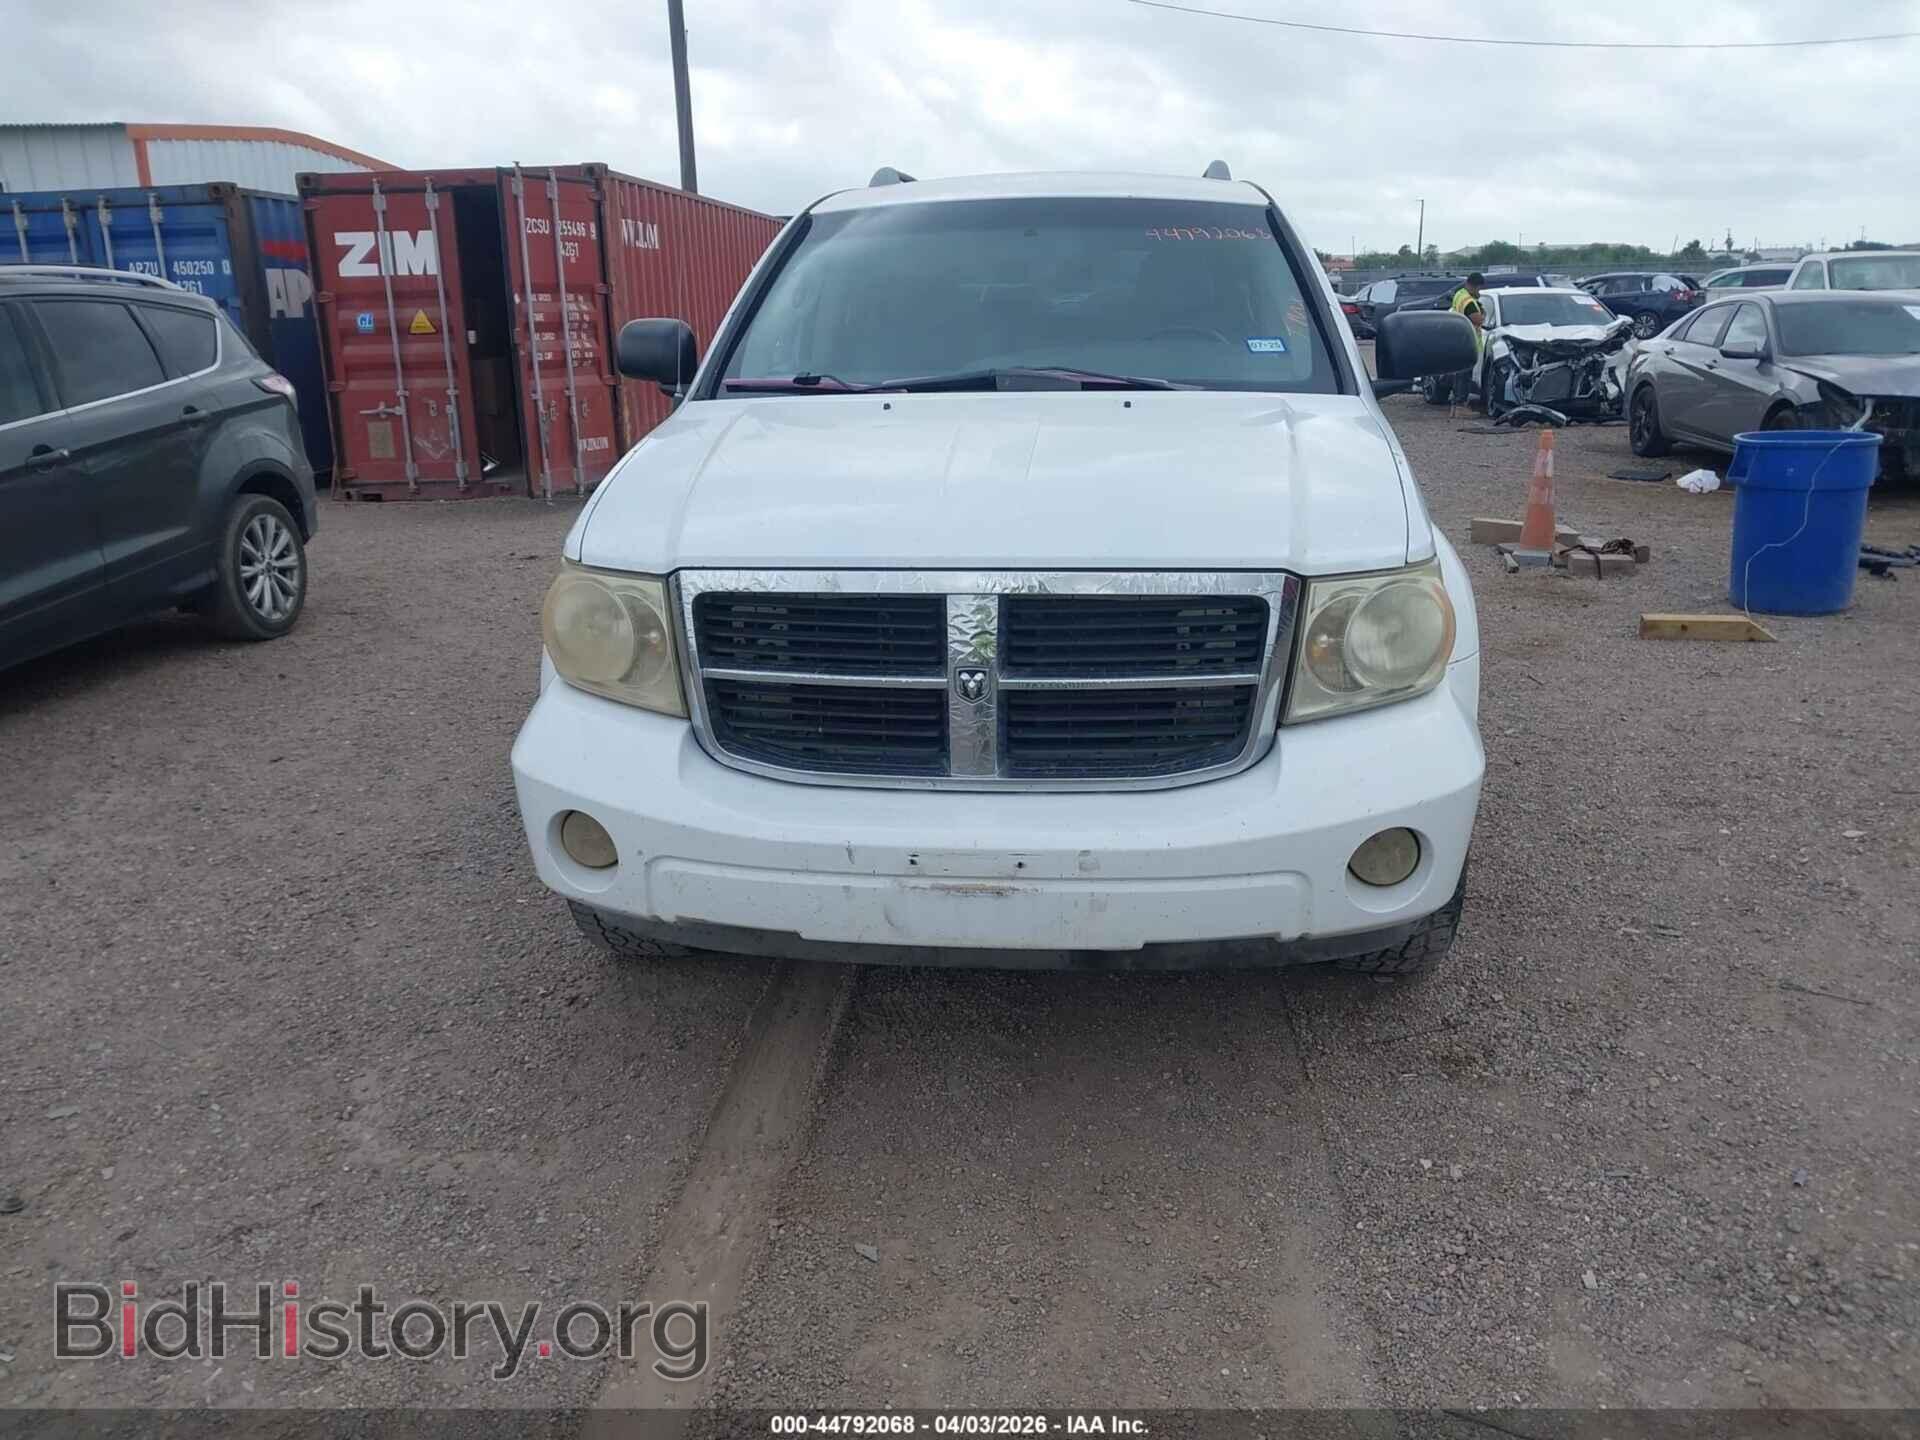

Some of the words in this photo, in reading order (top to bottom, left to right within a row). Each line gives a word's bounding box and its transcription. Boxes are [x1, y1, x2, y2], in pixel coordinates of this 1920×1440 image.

[525, 217, 550, 234] ZCSU
[334, 230, 440, 277] ZIM
[173, 260, 214, 275] 450250
